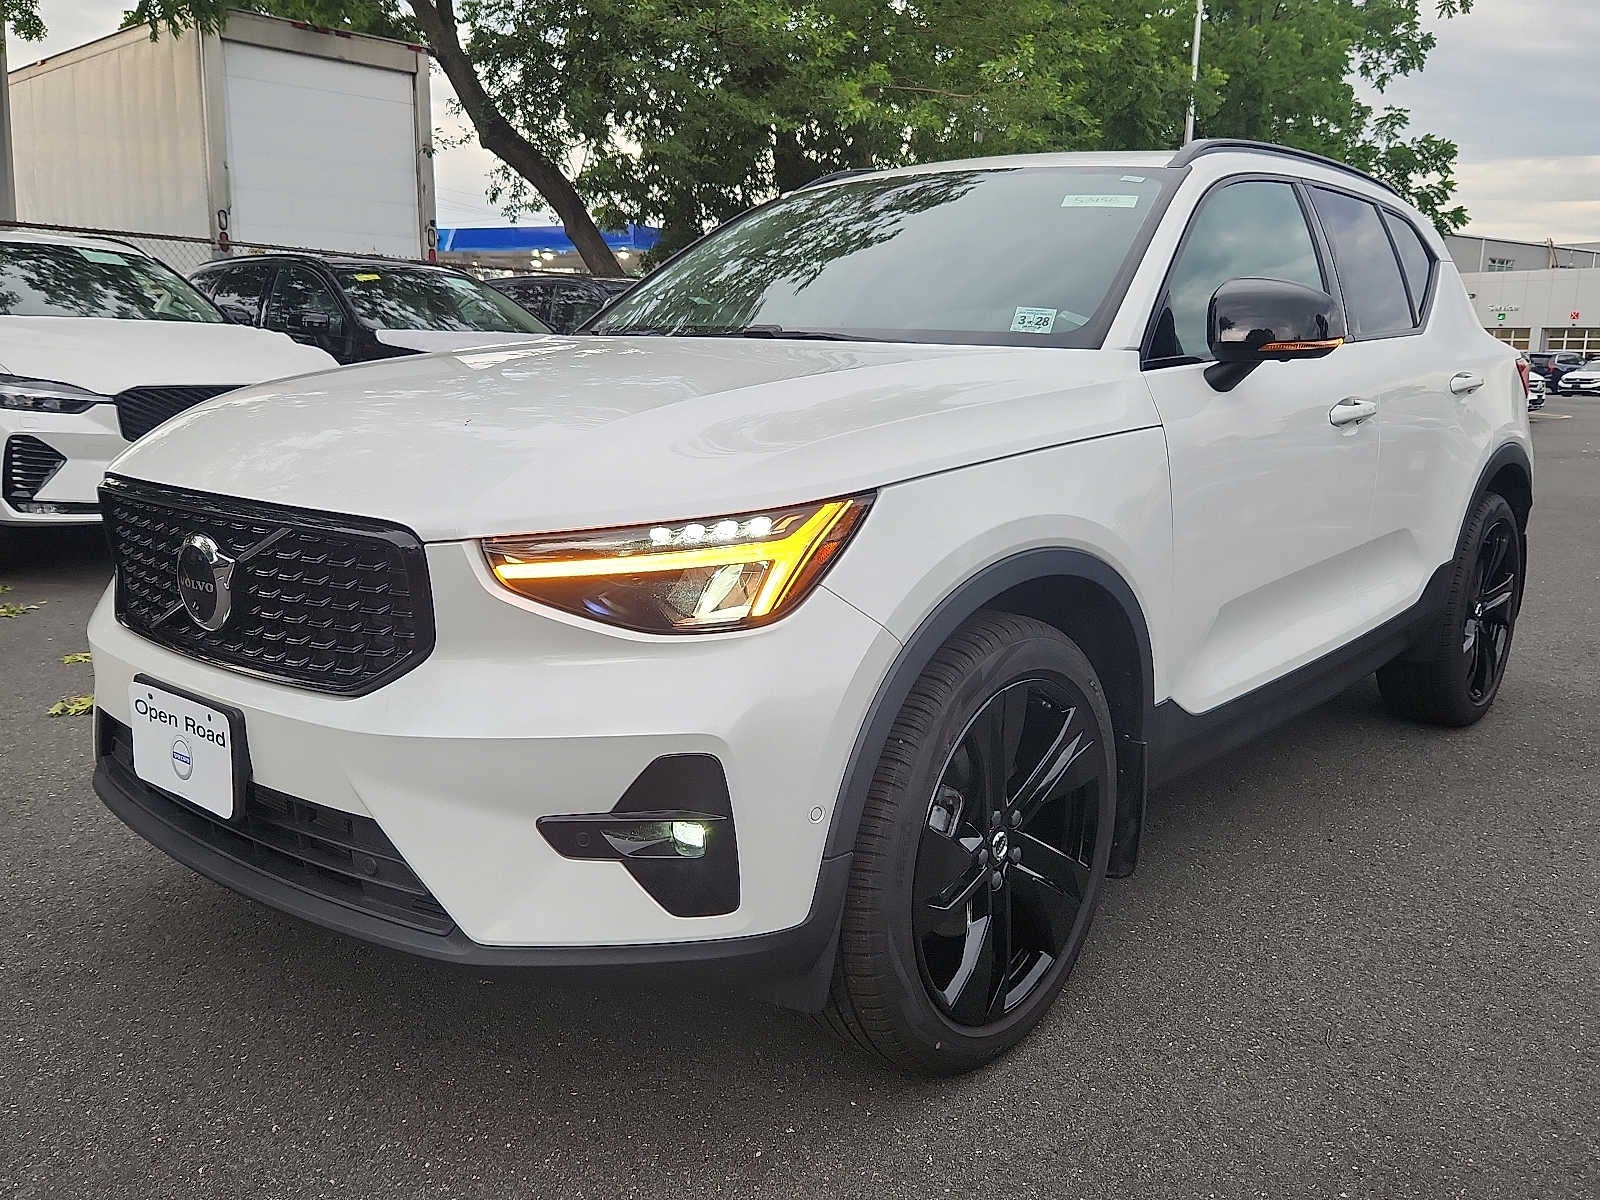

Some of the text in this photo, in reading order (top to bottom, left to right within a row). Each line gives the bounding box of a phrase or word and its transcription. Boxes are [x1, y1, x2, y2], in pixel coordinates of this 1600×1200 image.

[1018, 315, 1050, 327] 3 28
[180, 575, 214, 593] VOLVO
[134, 698, 227, 748] Open Road
